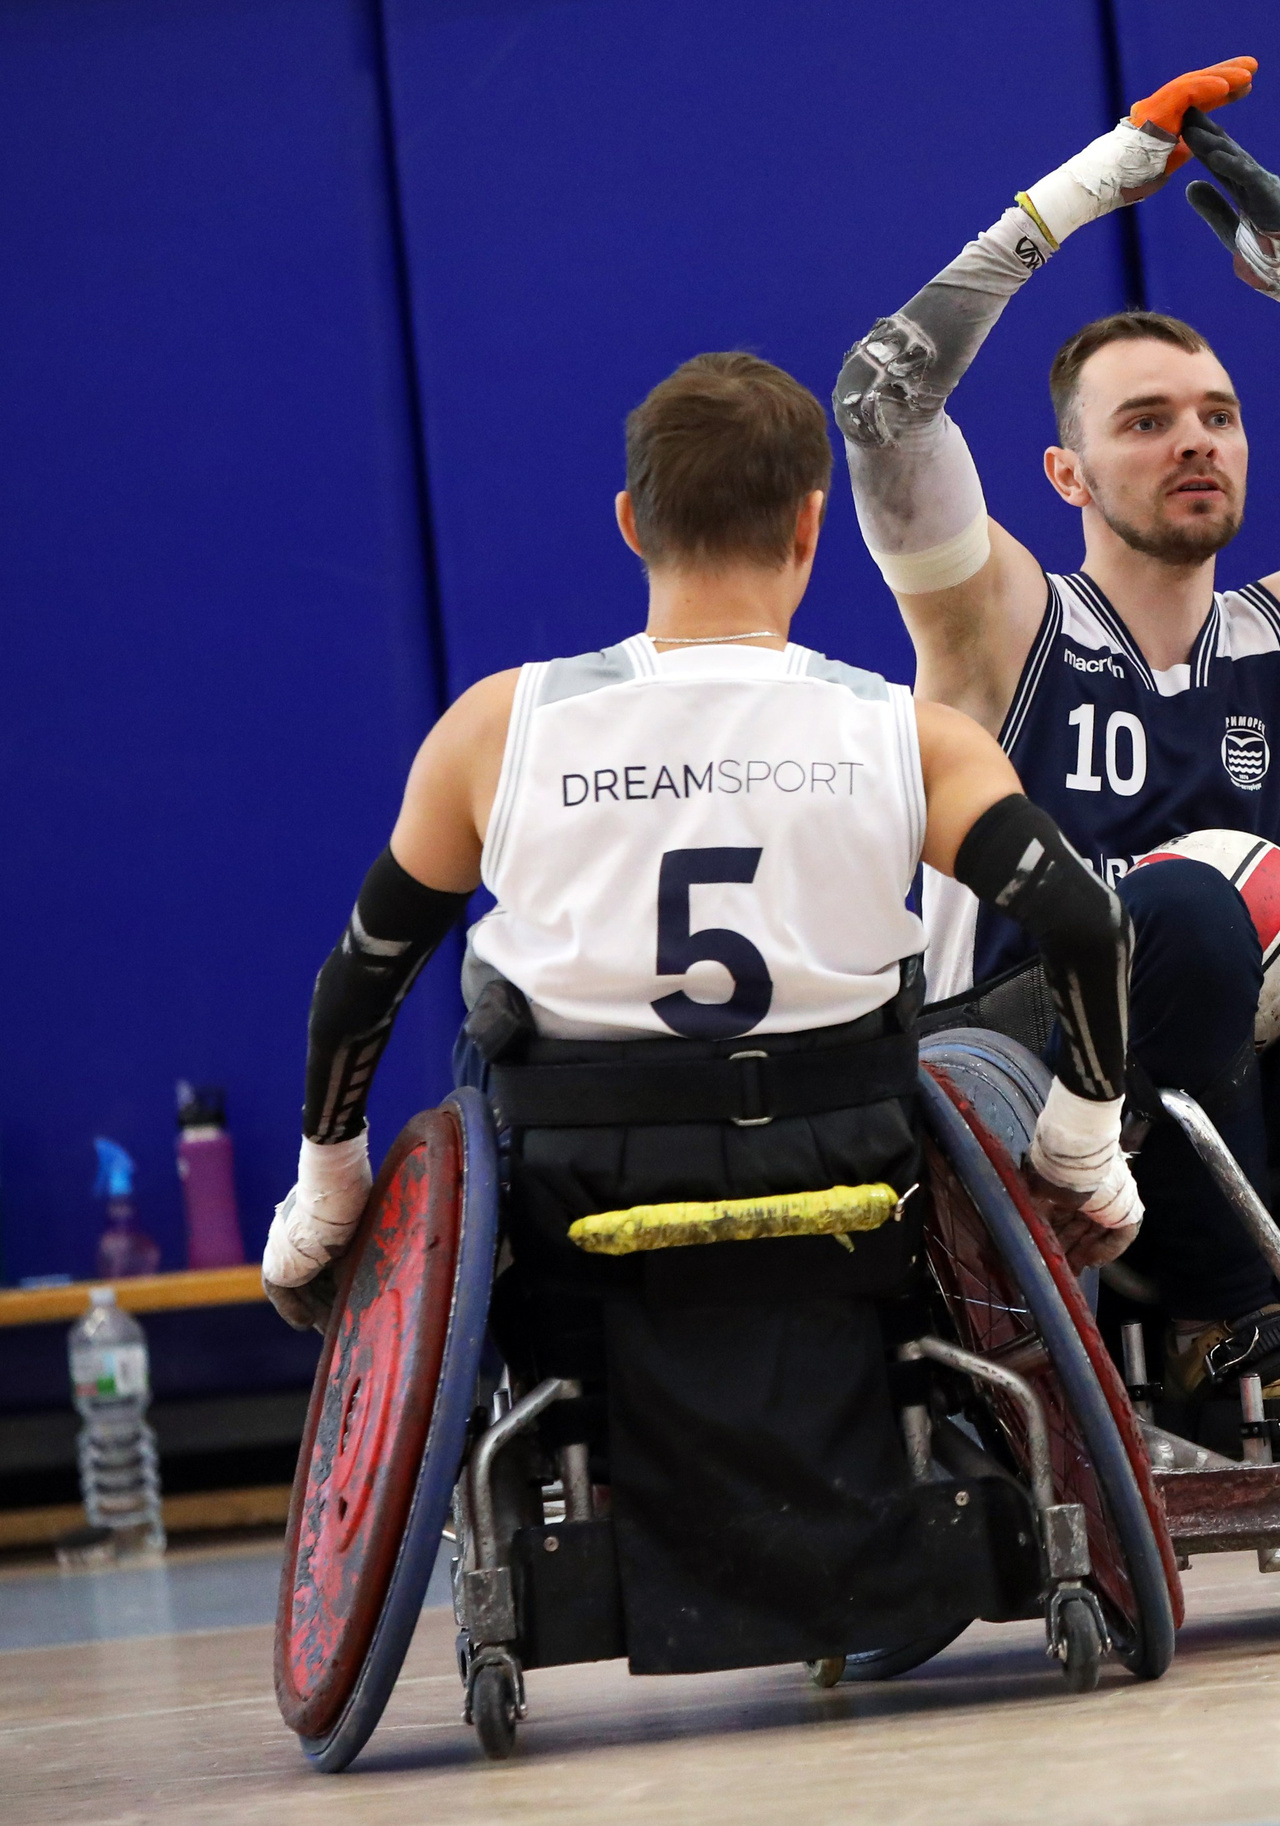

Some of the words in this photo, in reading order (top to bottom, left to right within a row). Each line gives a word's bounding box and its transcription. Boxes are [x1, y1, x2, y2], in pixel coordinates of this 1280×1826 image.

[561, 759, 865, 808] DREAMSPORT
[1065, 703, 1147, 796] 10
[650, 846, 773, 1042] 5
